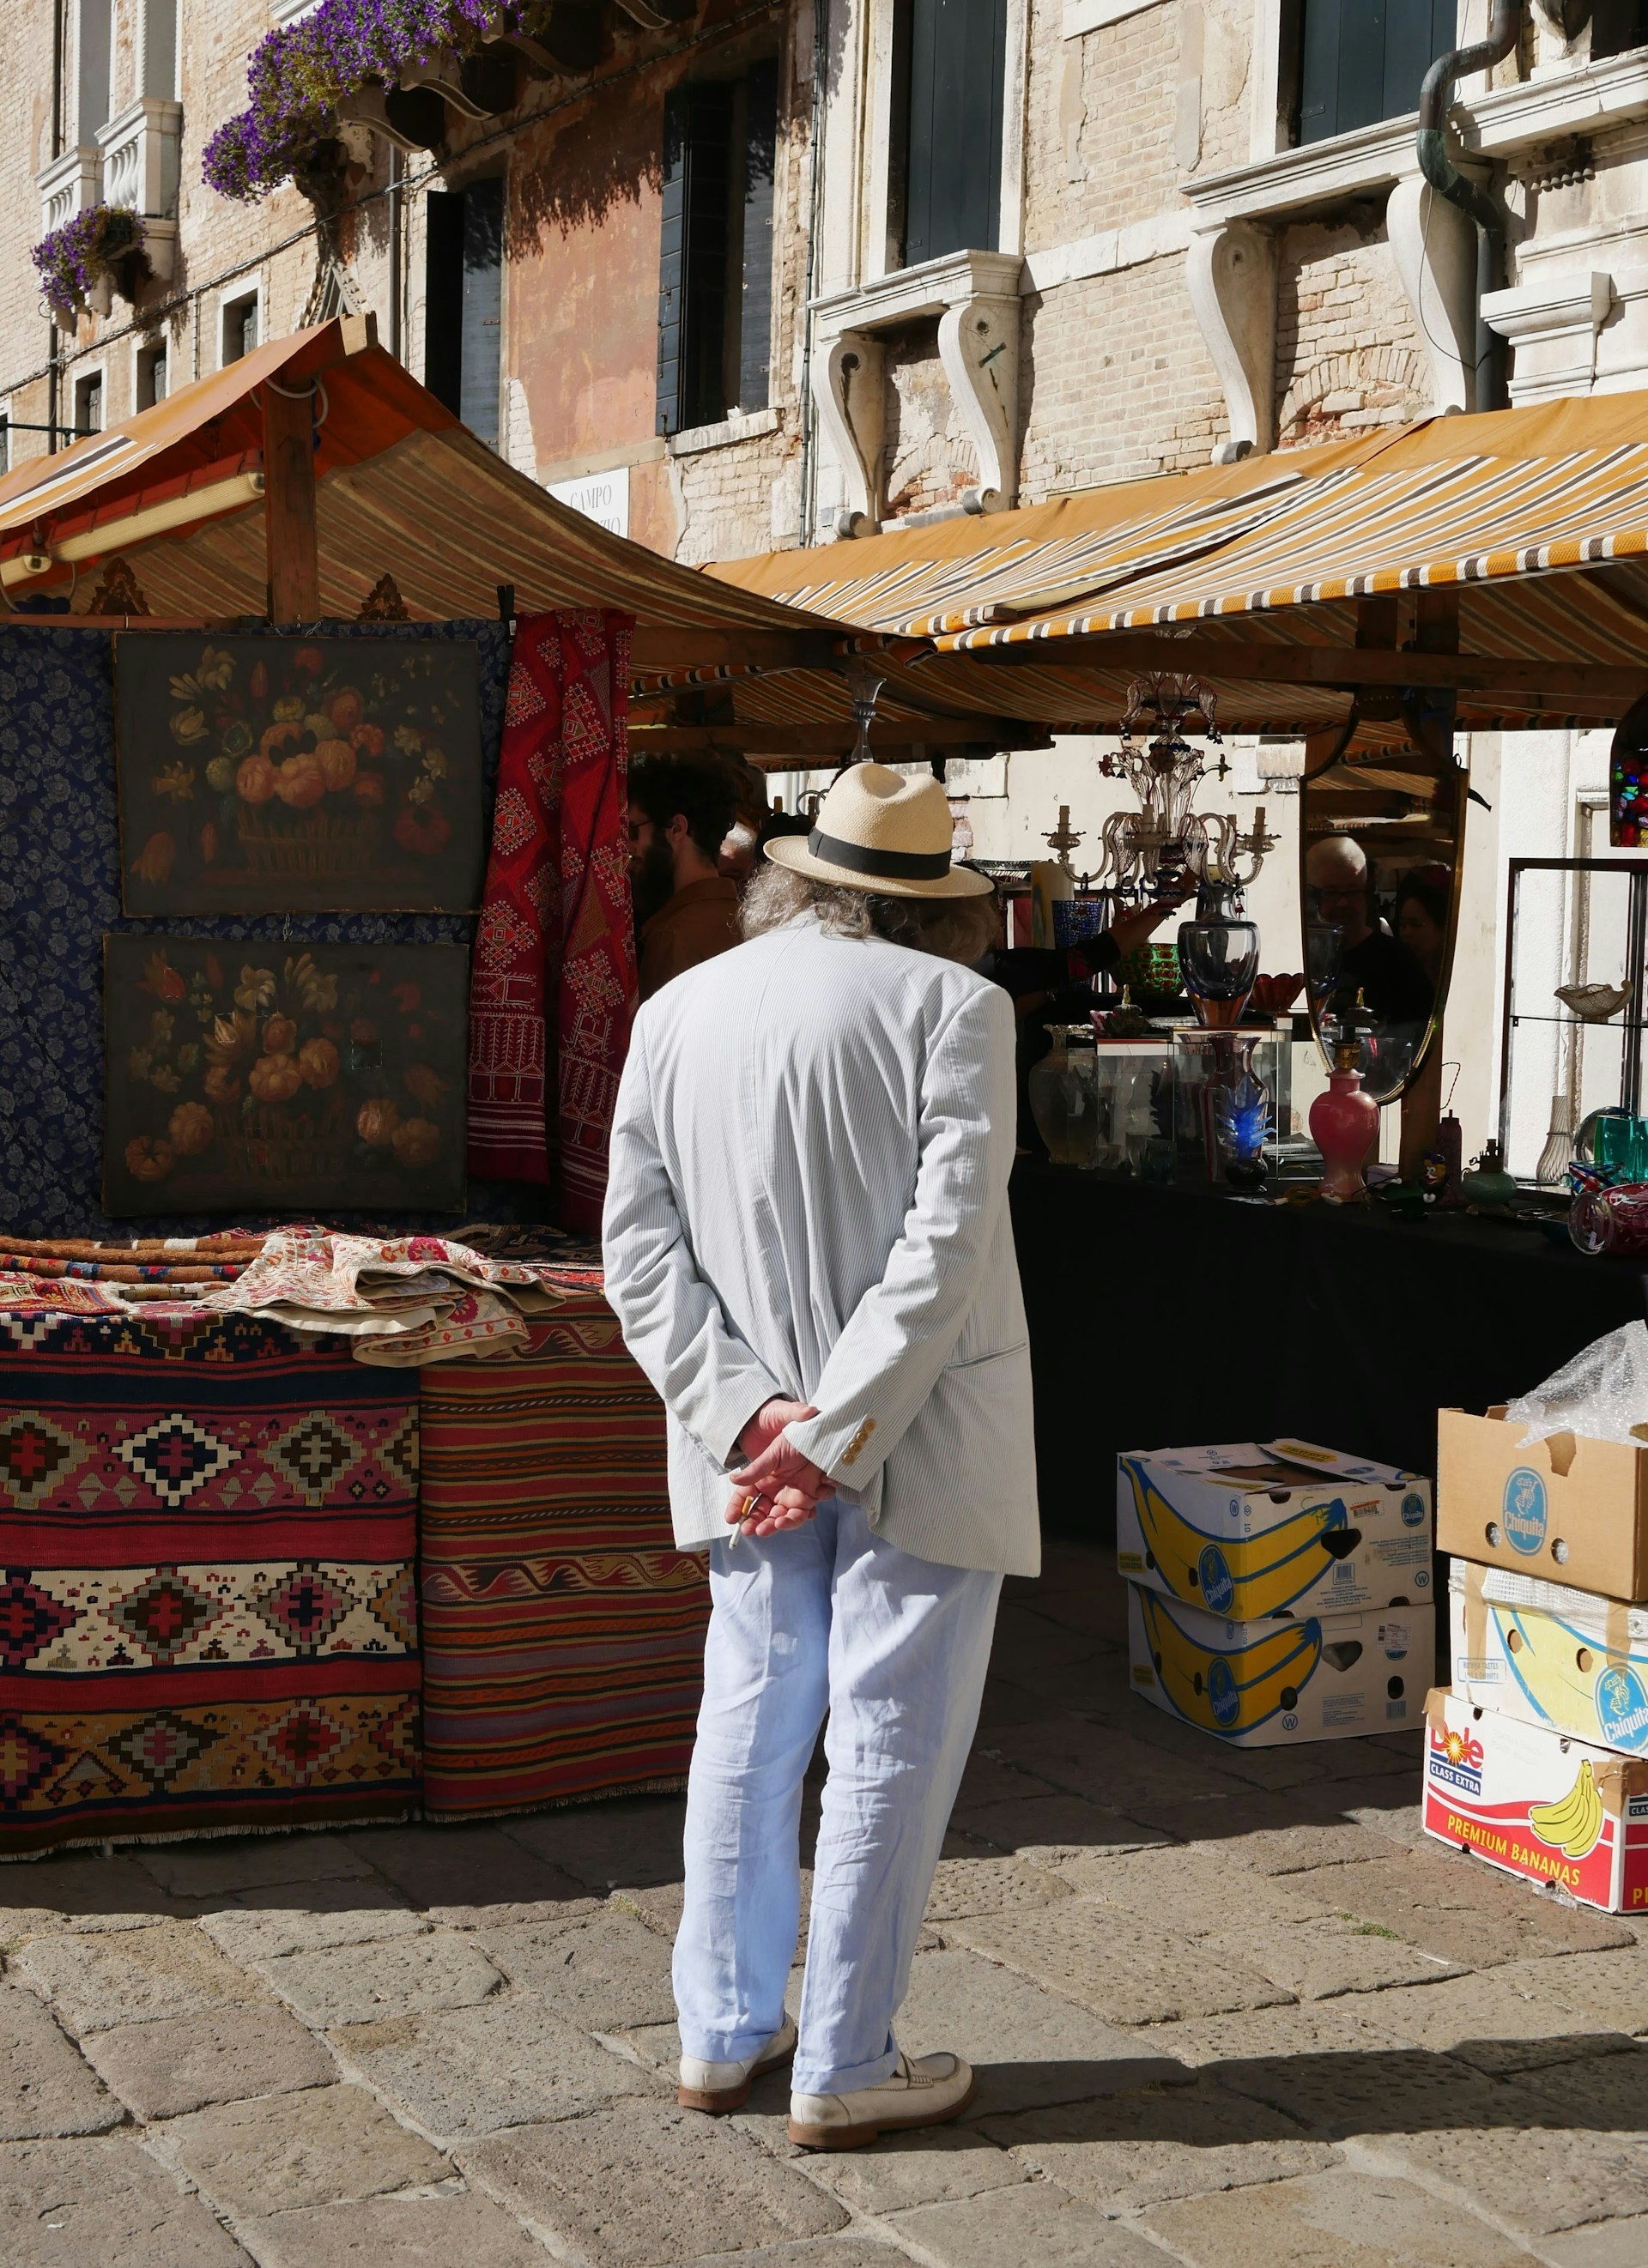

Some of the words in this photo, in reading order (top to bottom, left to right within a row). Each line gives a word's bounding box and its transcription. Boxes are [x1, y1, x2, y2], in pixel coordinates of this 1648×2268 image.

[570, 484, 612, 511] CAMPO
[1403, 1510, 1423, 1521] Chiquita
[1504, 1511, 1545, 1540] Chiquita
[1204, 1576, 1233, 1605] Chiquita
[1212, 1690, 1239, 1716] Chiquita
[1430, 1763, 1454, 1781] CLASS
[1455, 1774, 1481, 1793] EXTRA
[1447, 1813, 1507, 1856] PREMIUM
[1511, 1842, 1581, 1886] BANANAS
